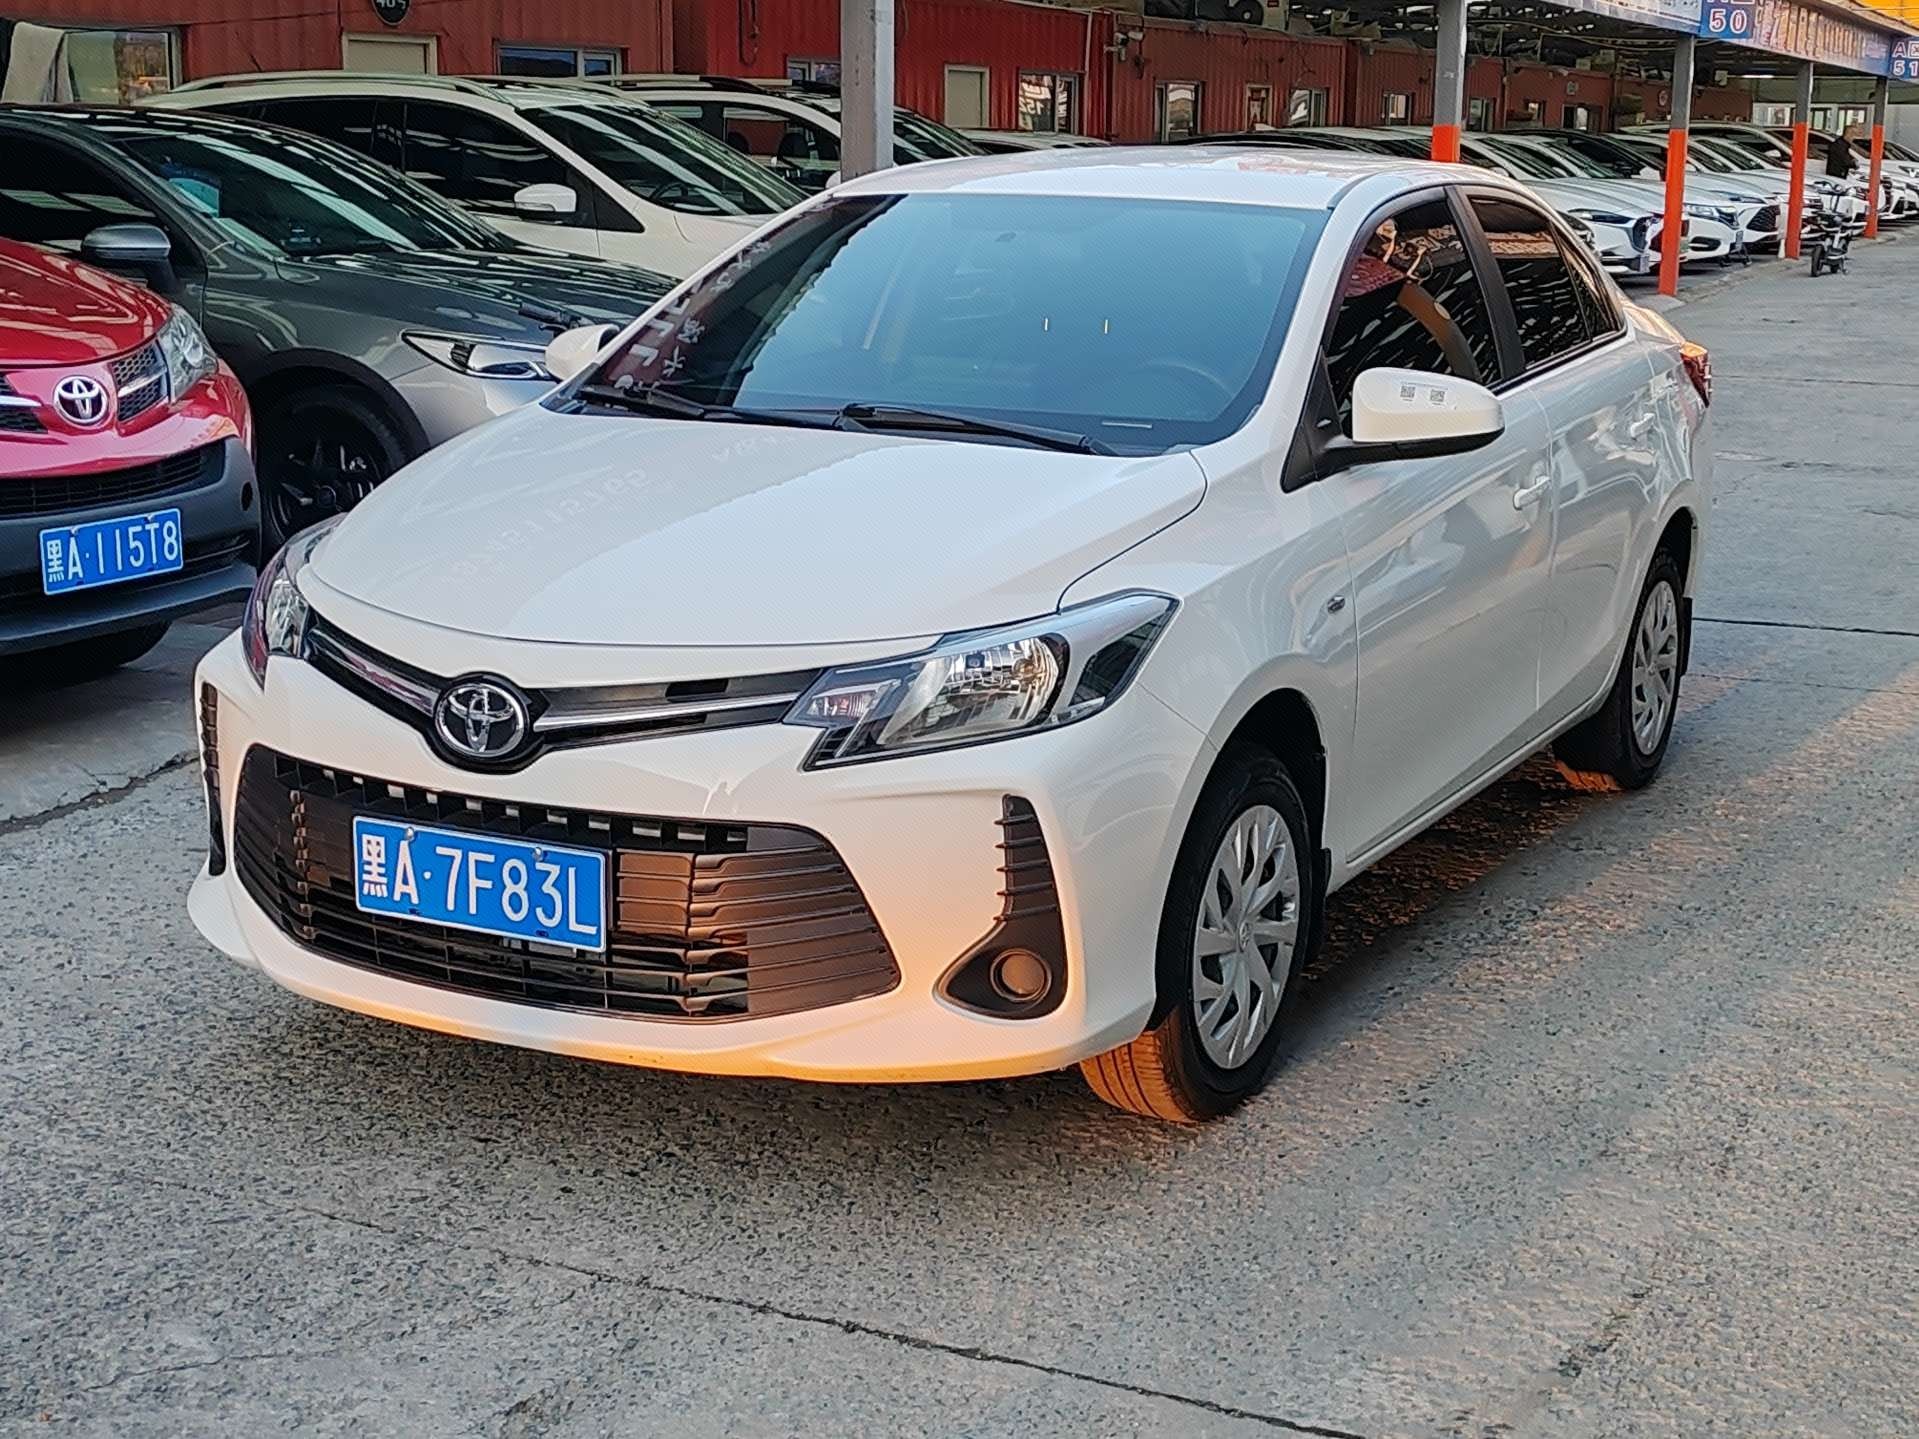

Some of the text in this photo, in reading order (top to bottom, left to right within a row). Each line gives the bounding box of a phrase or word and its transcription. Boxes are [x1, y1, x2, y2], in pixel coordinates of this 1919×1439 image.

[1708, 8, 1748, 35] 50
[1892, 60, 1919, 76] 51
[361, 833, 598, 935] 黑A·7F83L
